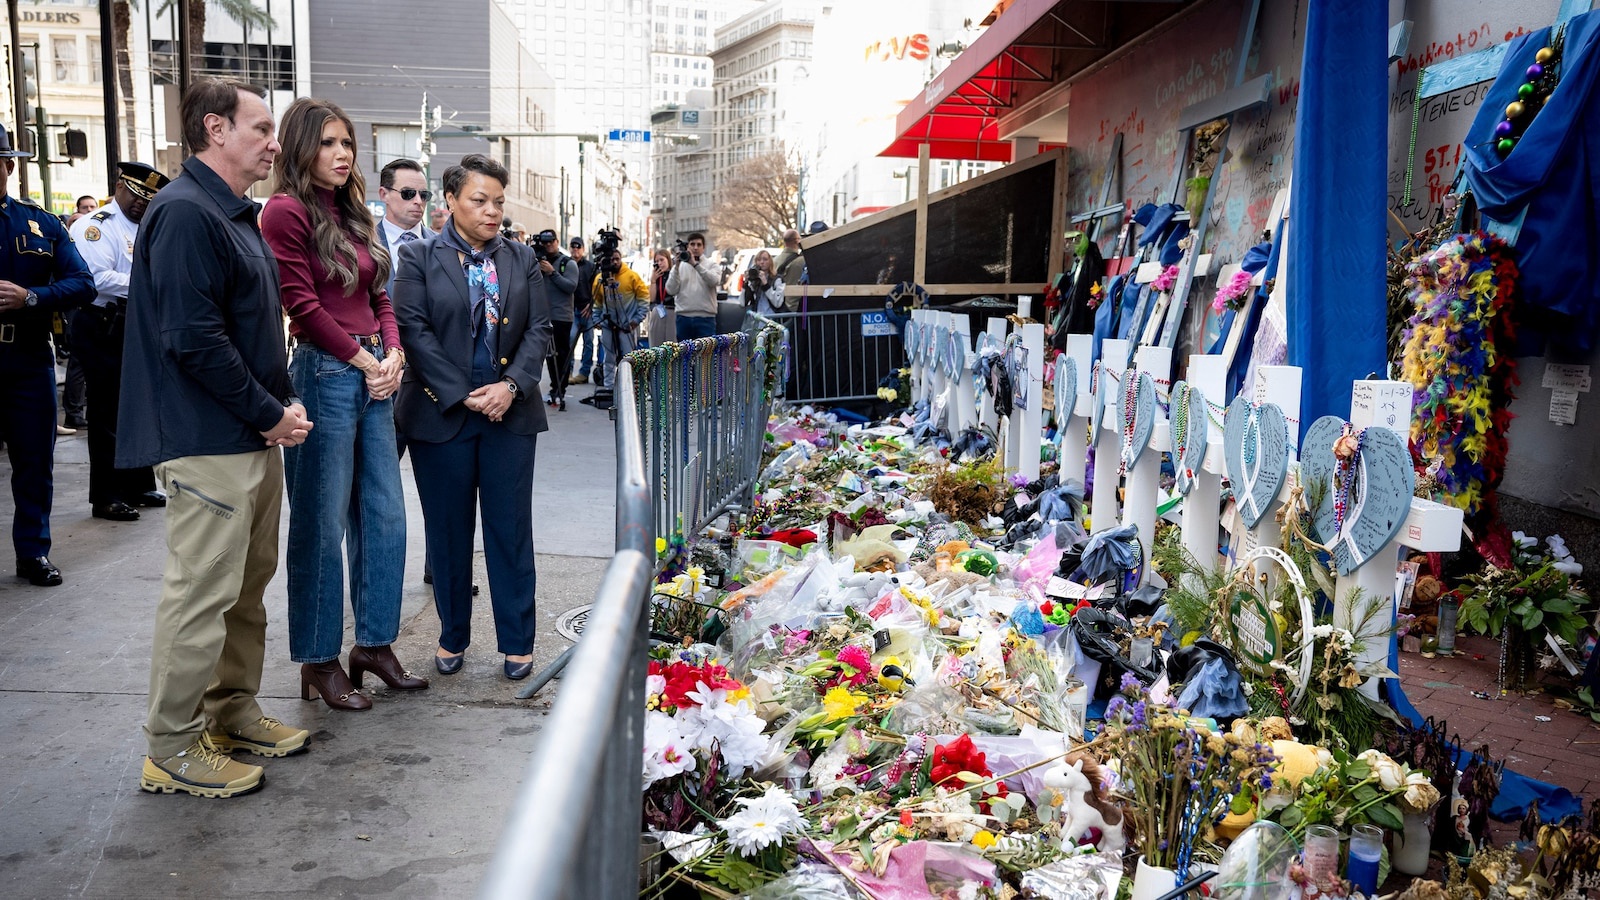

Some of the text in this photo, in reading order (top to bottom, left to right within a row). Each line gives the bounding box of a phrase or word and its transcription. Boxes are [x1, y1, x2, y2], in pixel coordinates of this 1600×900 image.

[1397, 22, 1491, 77] Washington
[1155, 59, 1204, 109] Canada
[1187, 79, 1217, 106] with
[619, 130, 644, 142] Canal
[888, 281, 930, 304] EMS
[863, 315, 886, 324] N.O.
[1380, 386, 1411, 398] 1-1-25
[208, 505, 233, 520] KUIU
